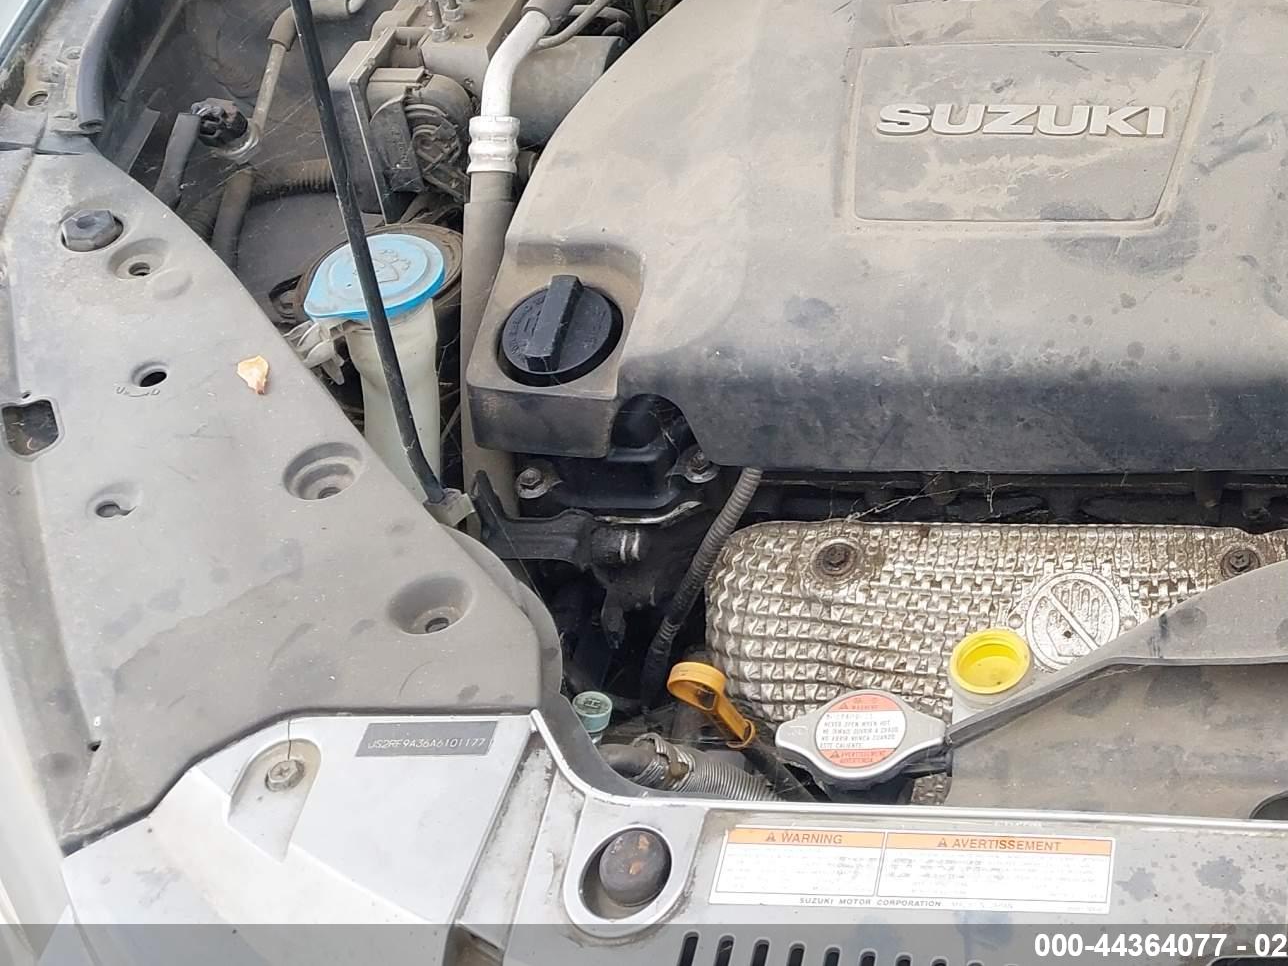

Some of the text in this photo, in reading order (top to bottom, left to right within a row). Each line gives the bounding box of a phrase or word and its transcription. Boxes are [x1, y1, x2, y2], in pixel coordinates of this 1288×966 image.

[876, 104, 1169, 138] SUZUKI
[781, 832, 843, 844] WARNING
[952, 838, 1062, 851] AVERTISSEMENT
[800, 897, 834, 905] SUZUKI
[877, 898, 942, 907] CORPORATION
